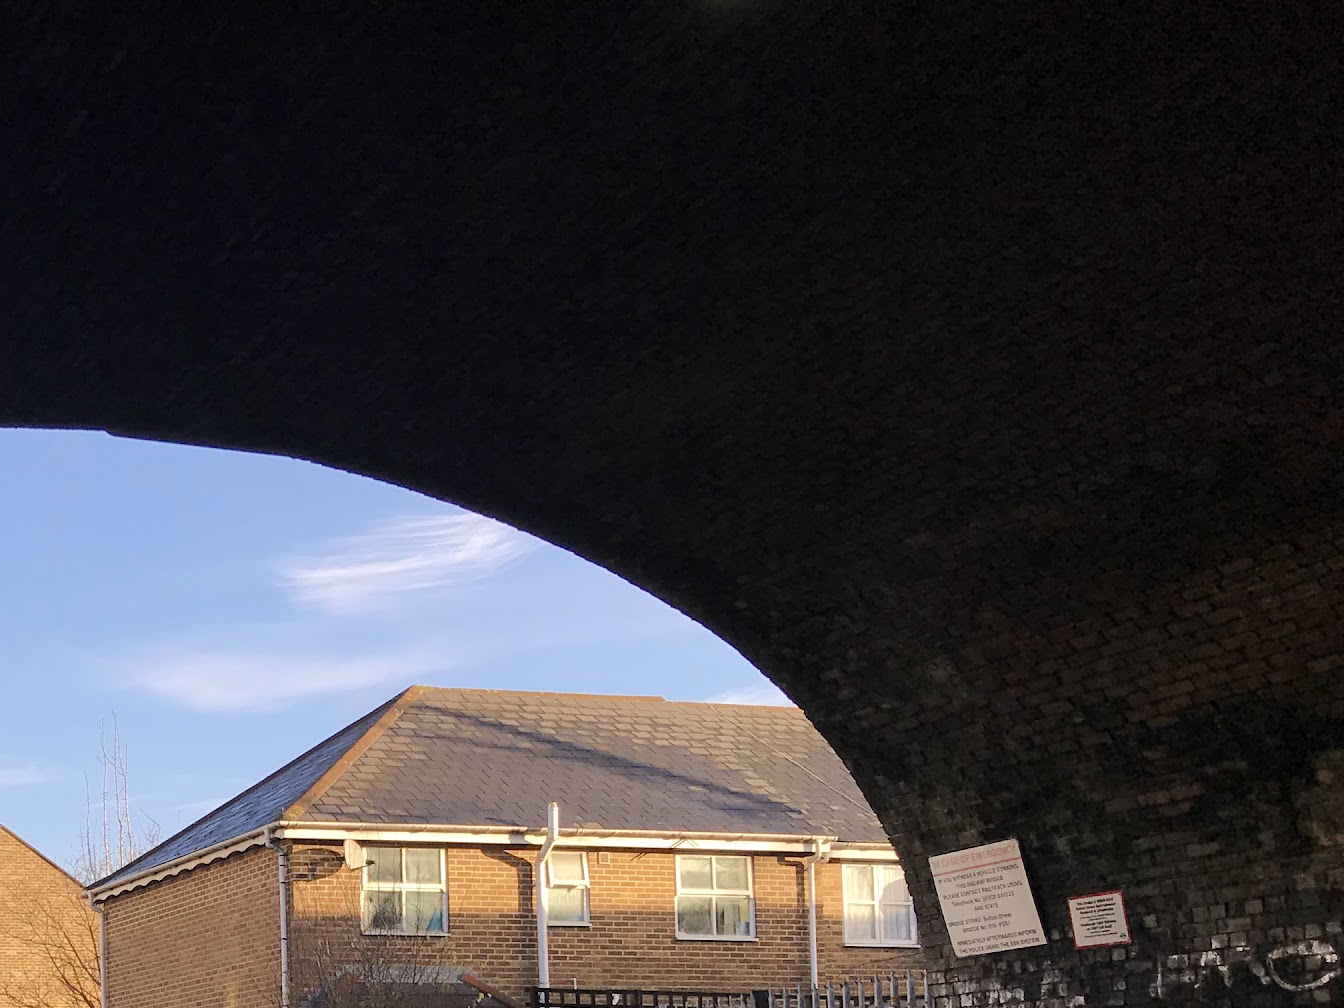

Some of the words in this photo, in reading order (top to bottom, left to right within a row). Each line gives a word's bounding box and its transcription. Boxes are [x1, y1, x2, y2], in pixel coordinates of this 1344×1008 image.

[940, 857, 960, 867] CASE
[970, 845, 1017, 860] EMERGENCY
[997, 864, 1019, 872] STRIKING
[960, 889, 982, 897] CONTACT
[951, 899, 974, 907] Telephone
[957, 938, 986, 946] IMMEDIATELY
[986, 933, 1017, 941] AFTERWARDS
